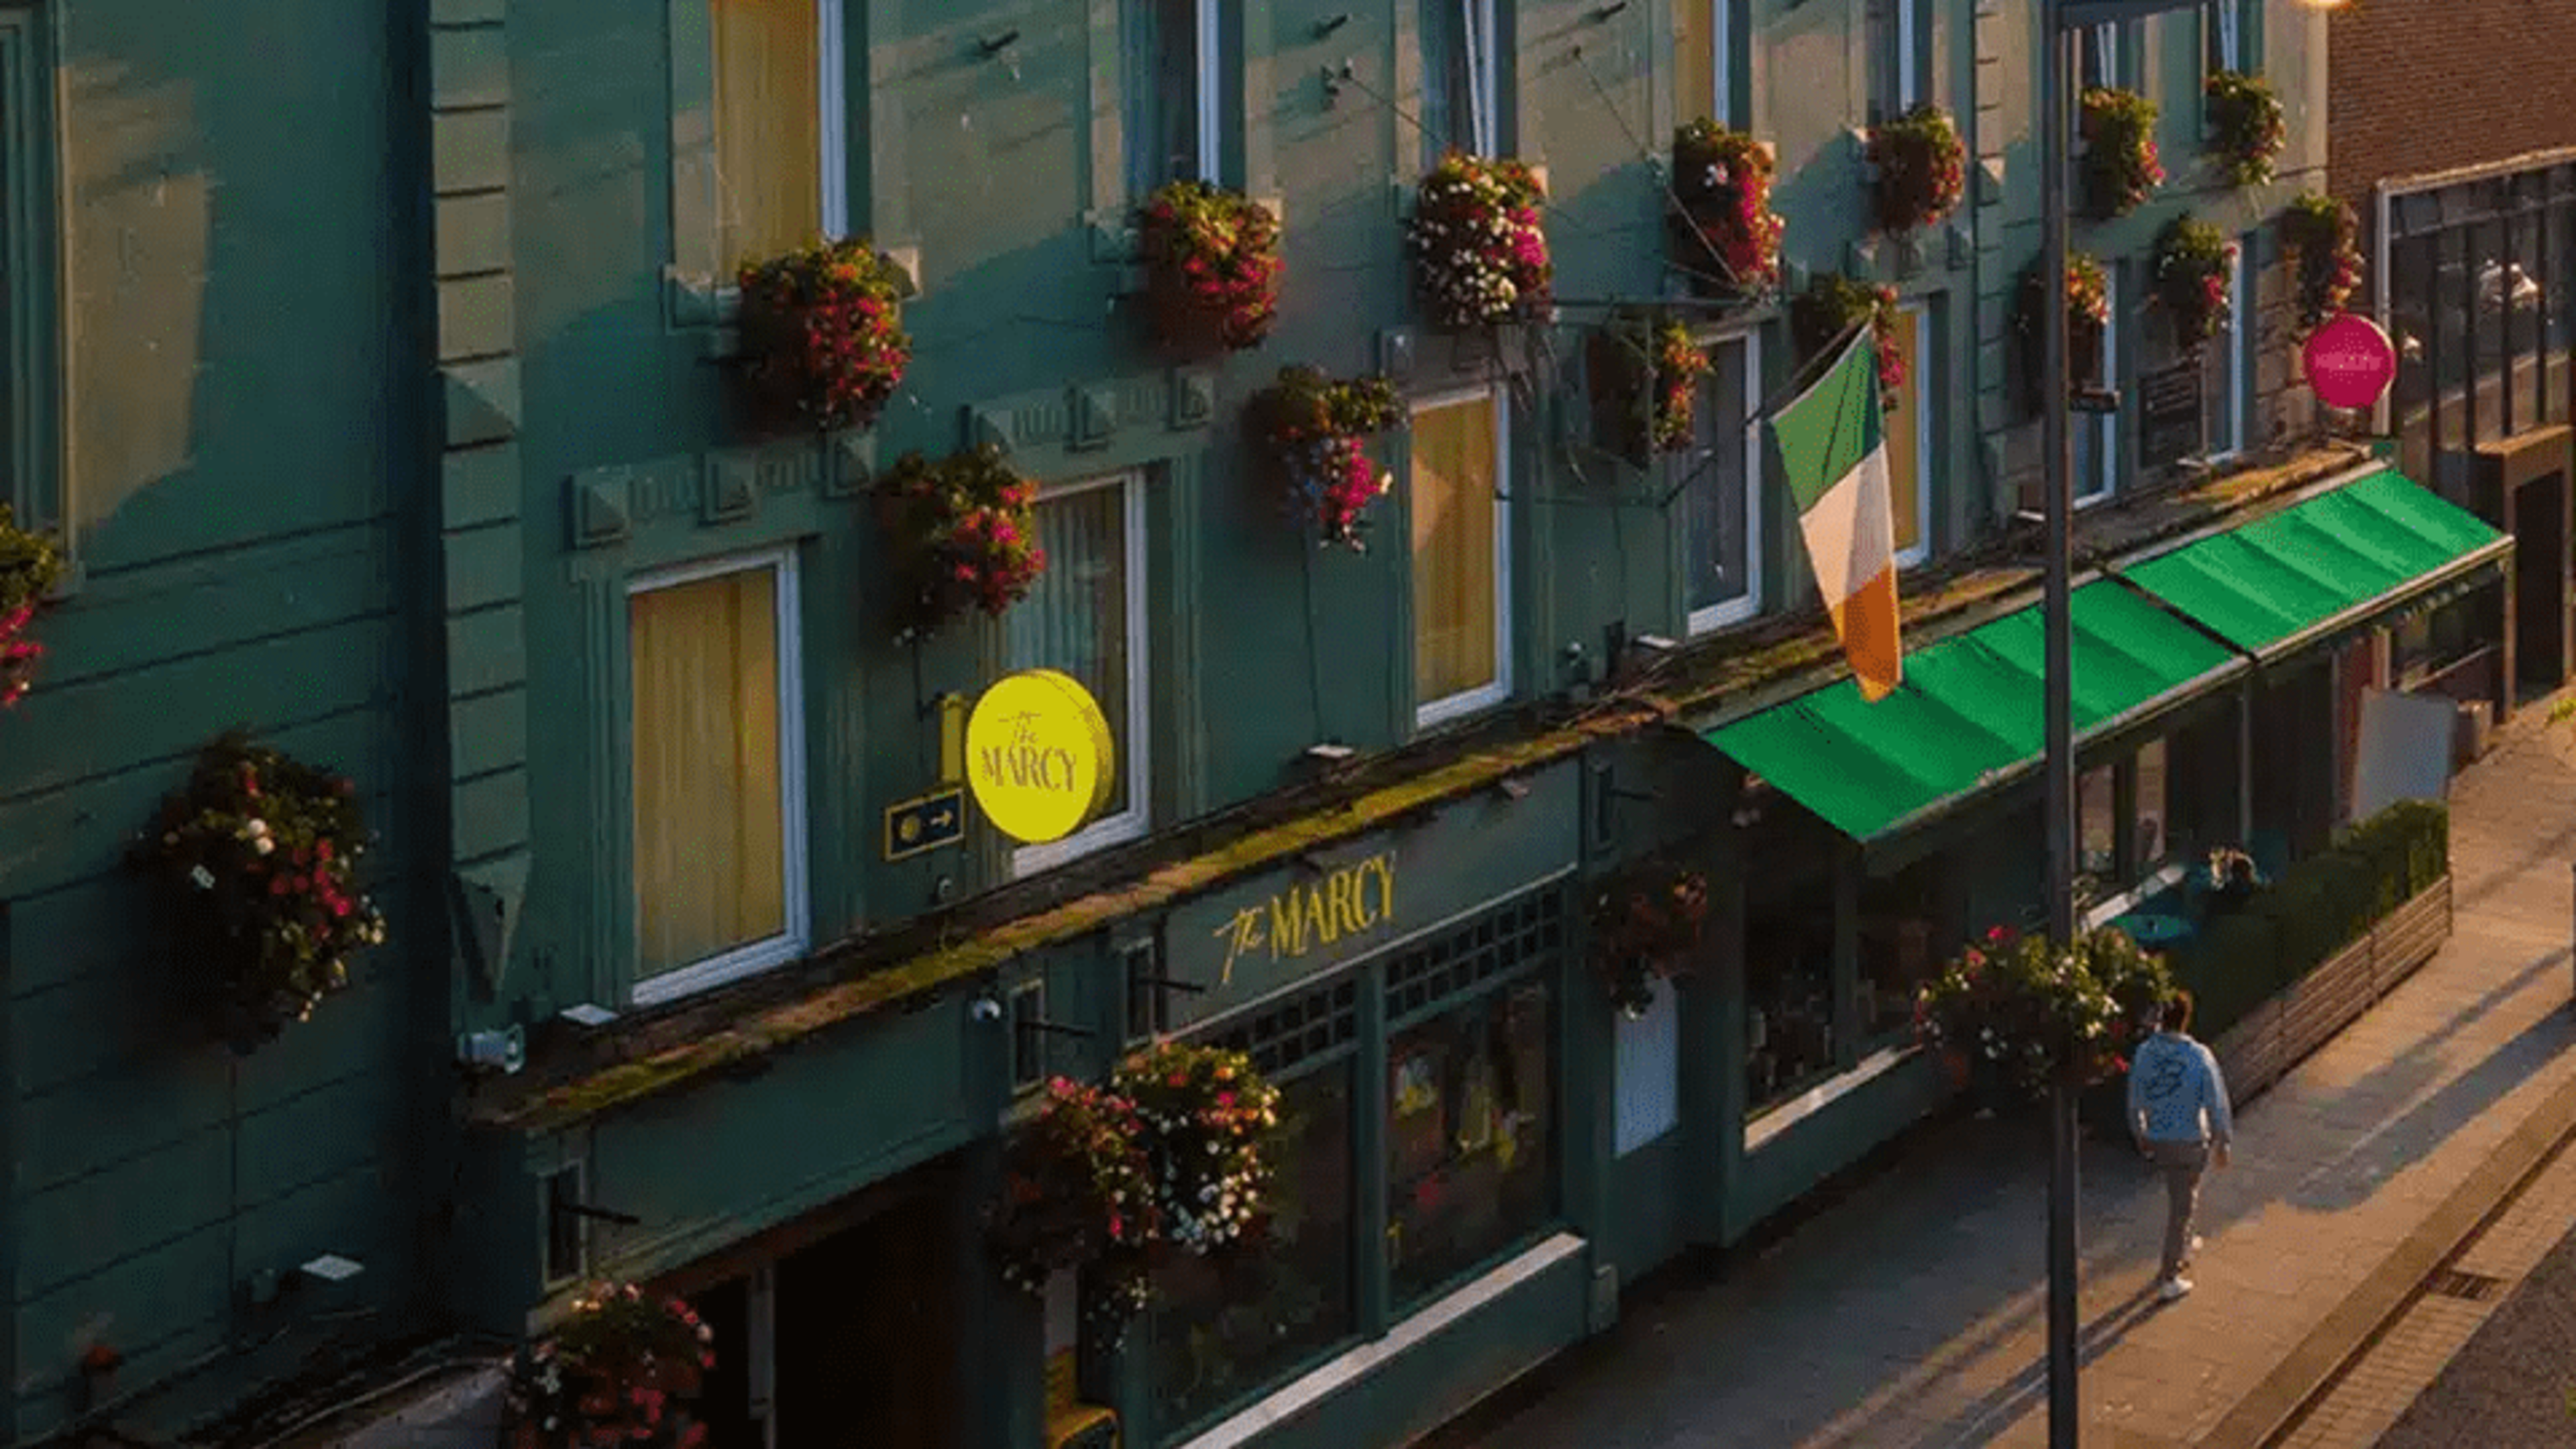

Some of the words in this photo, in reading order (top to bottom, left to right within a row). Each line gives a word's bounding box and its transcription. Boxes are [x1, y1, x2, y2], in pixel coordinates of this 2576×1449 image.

[981, 745, 1077, 792] MARCY
[1213, 906, 1265, 985] The
[1271, 849, 1397, 962] MARCY
